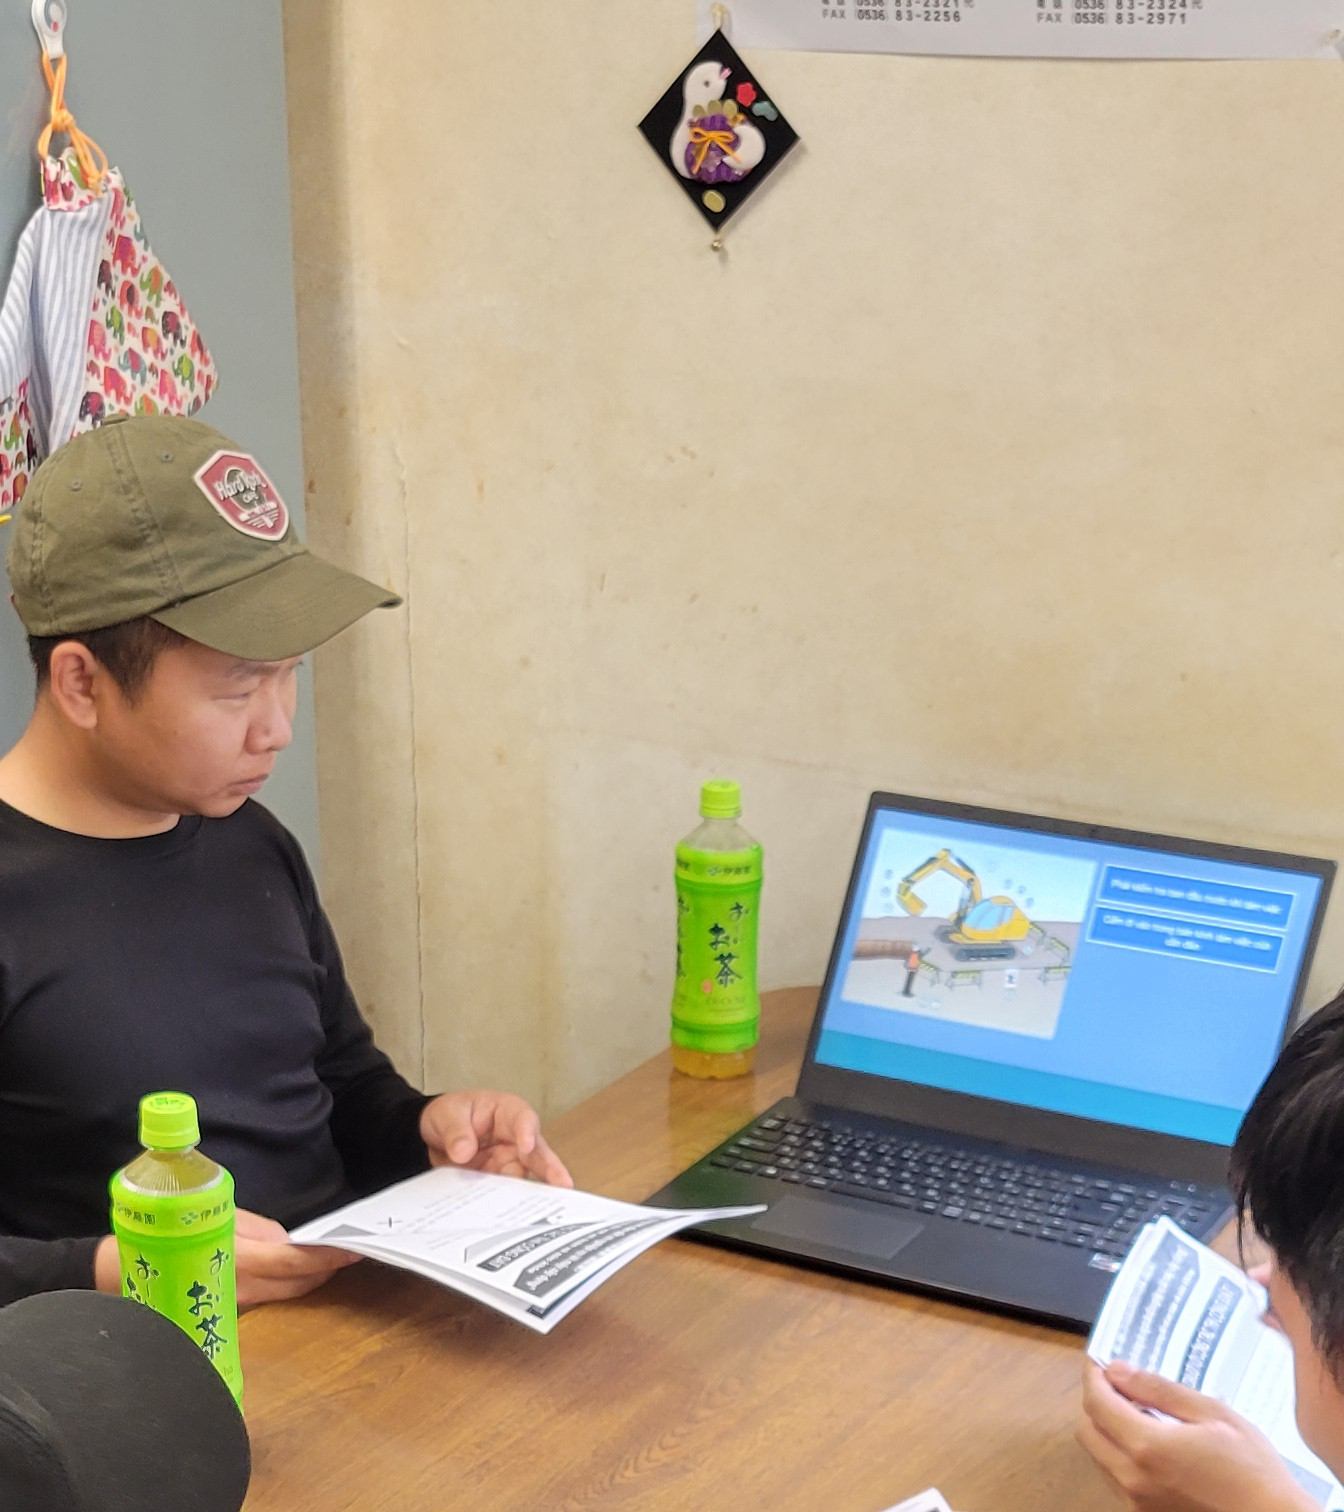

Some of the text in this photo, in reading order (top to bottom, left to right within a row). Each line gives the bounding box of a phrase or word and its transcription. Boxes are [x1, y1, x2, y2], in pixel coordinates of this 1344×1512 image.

[822, 9, 846, 20] FAX
[895, 10, 961, 22] 83-2256
[1036, 12, 1062, 23] FAX
[1115, 13, 1188, 25] 83-2971
[186, 1279, 228, 1361] お茶
